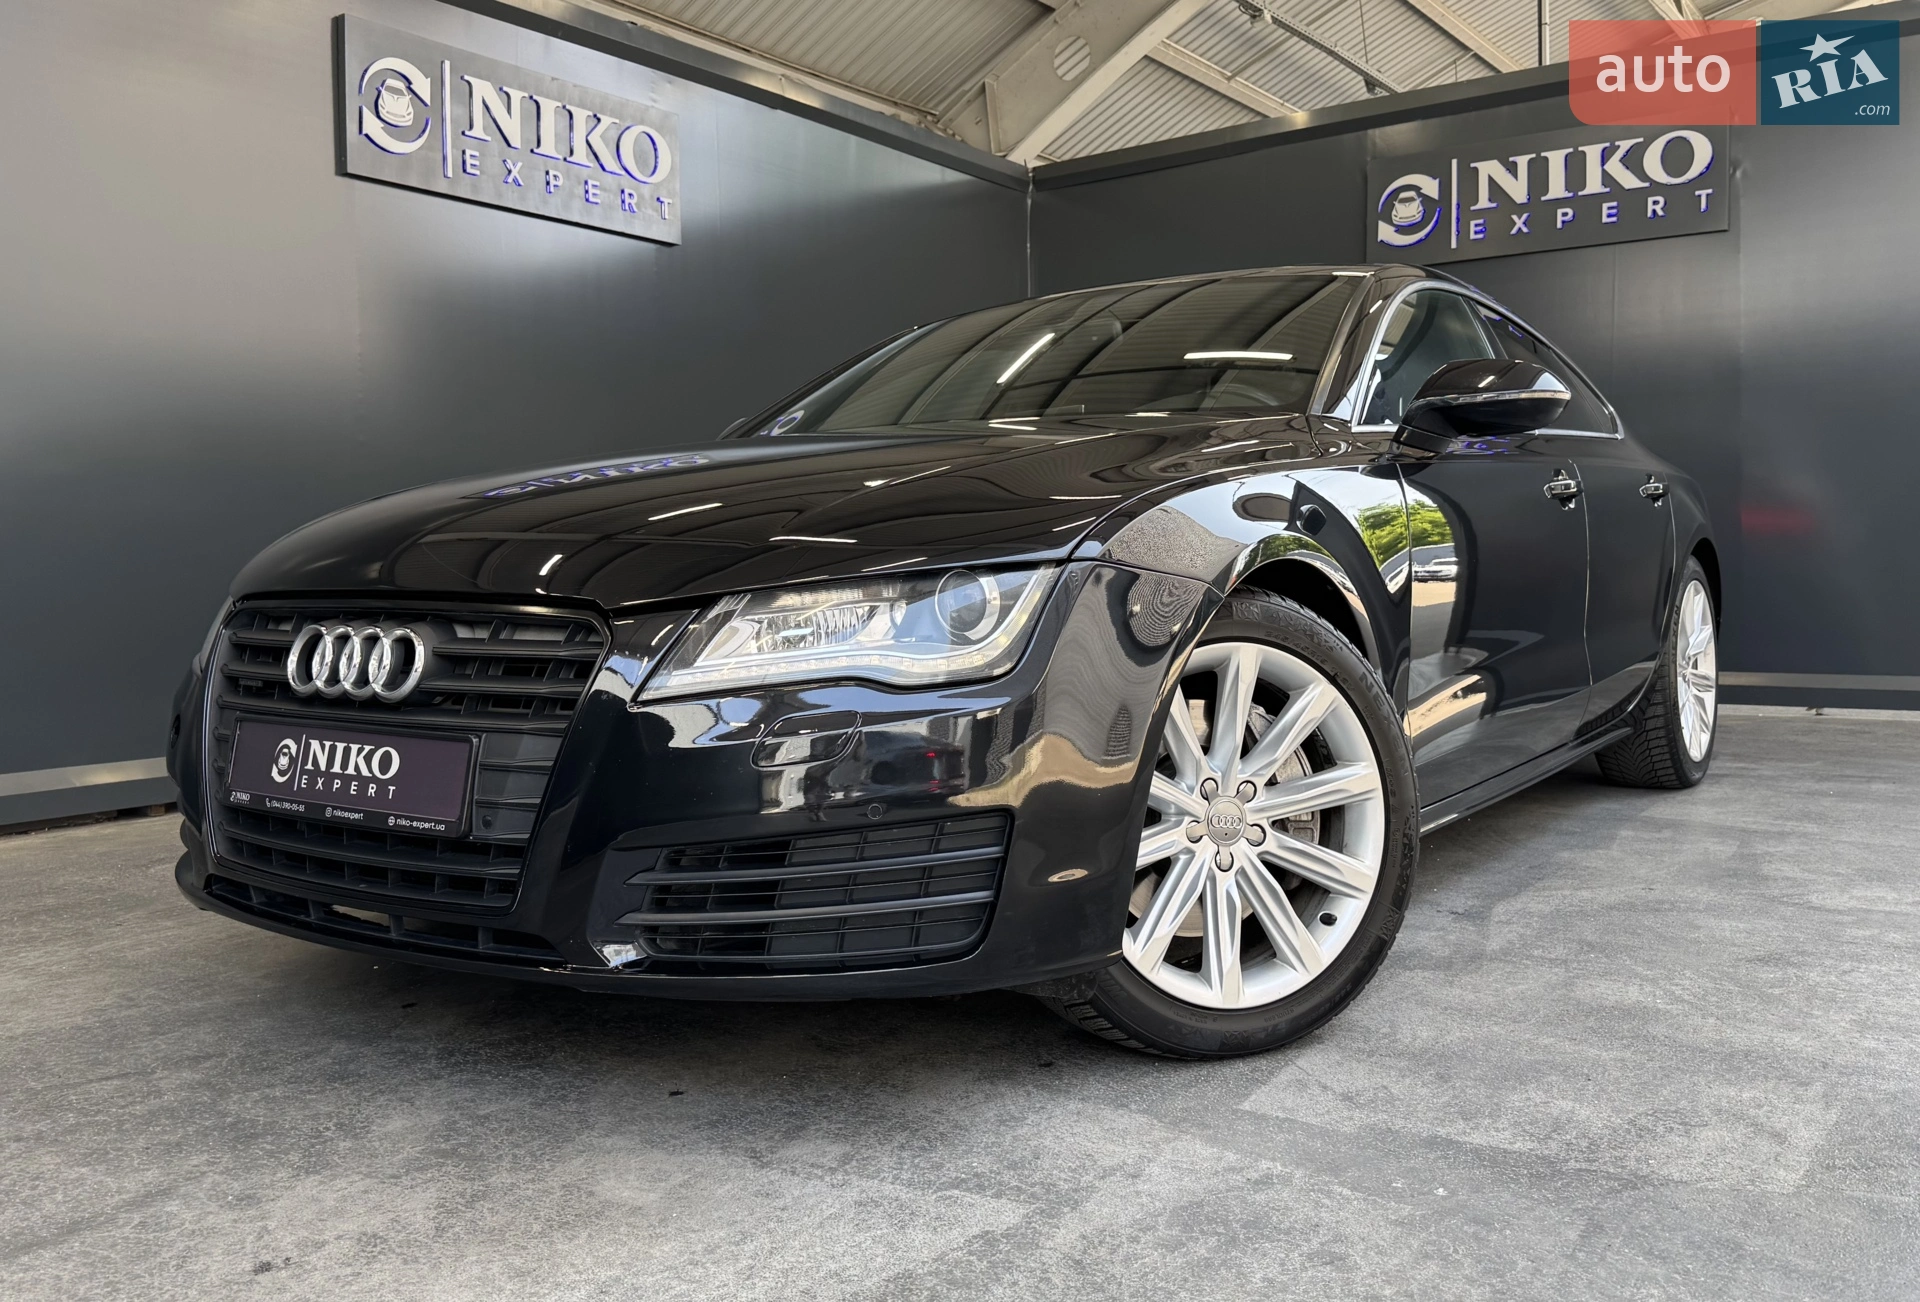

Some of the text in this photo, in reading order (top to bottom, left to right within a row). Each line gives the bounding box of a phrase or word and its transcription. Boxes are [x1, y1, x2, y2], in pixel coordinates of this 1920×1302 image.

[460, 74, 672, 184] NIKO
[462, 148, 673, 220] EXPERT
[1469, 129, 1714, 212] NIKO
[1469, 188, 1713, 240] EXPERT
[304, 739, 400, 779] NIKO
[301, 775, 396, 799] EXPERT
[333, 808, 364, 820] nikoexpert
[396, 817, 445, 831] niko-expert.ua
